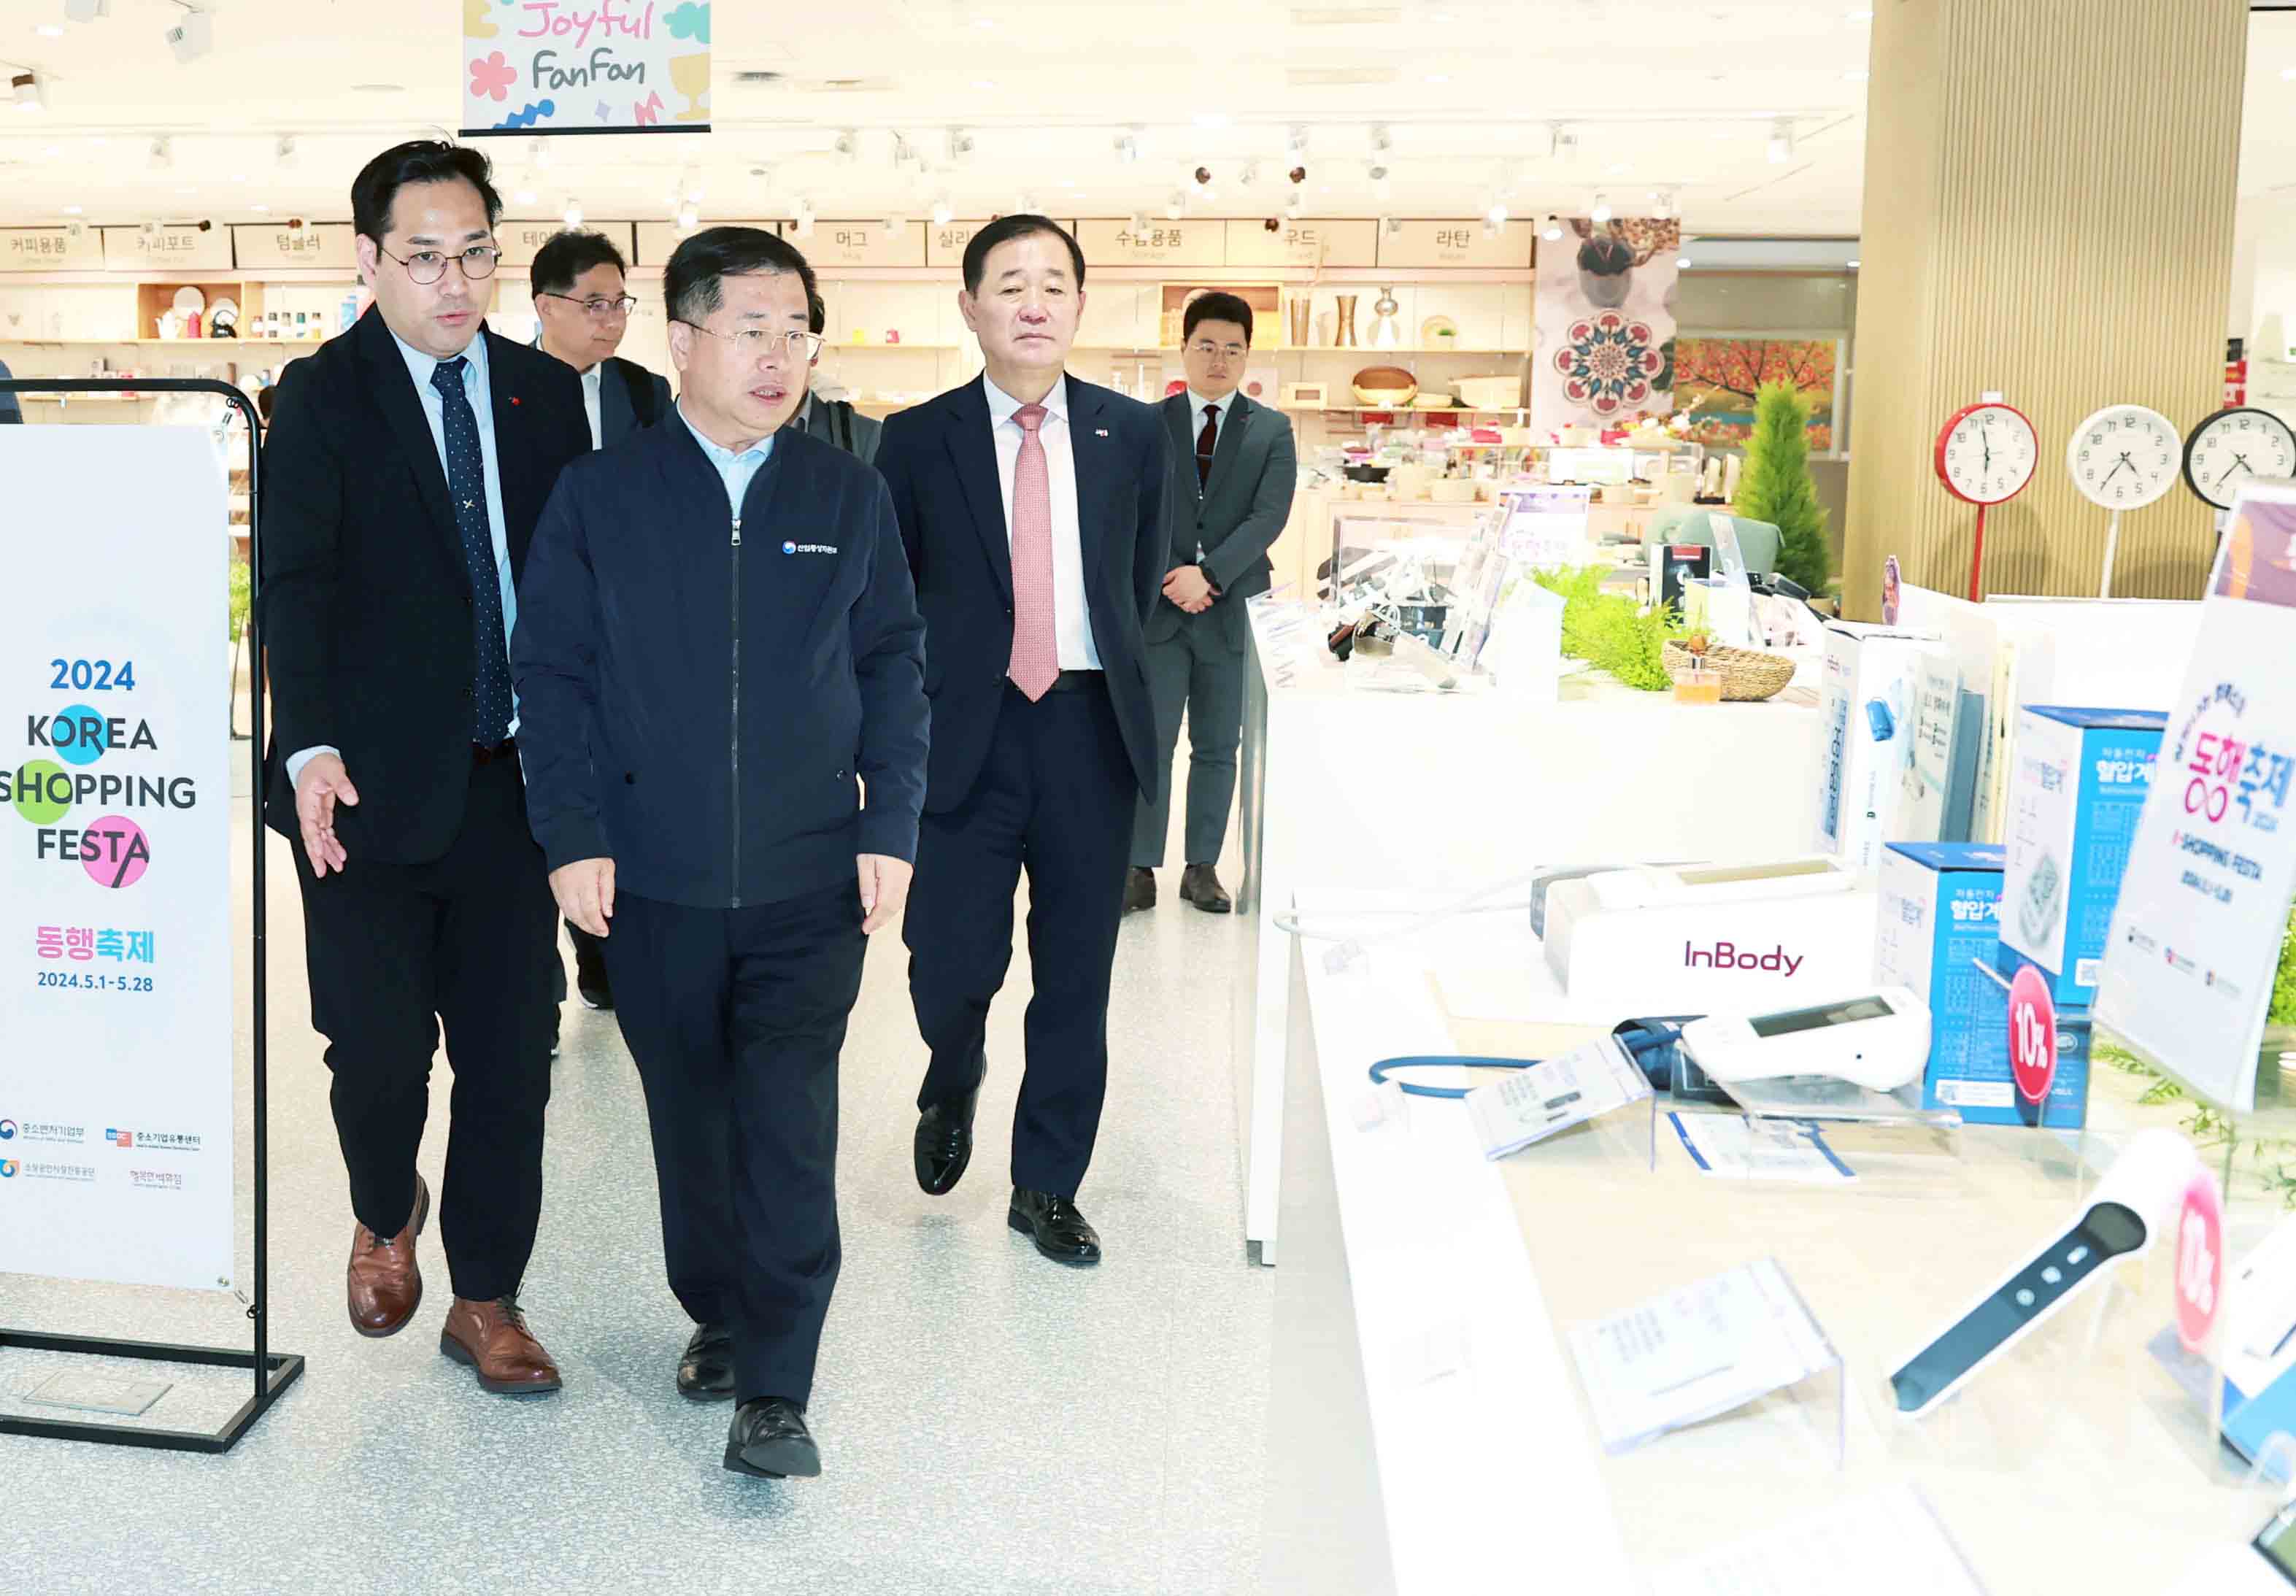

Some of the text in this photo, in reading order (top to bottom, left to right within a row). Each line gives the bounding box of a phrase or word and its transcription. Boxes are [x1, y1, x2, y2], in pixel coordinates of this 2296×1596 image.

[517, 0, 654, 48] Joyful
[11, 236, 67, 254] 커피용품
[836, 228, 868, 247] 머그
[939, 229, 972, 248] 실리
[1436, 229, 1471, 248] 라탄
[50, 658, 136, 690] 2024
[27, 714, 158, 756] KOREA
[0, 764, 196, 809] SHOPPING
[36, 828, 150, 889] FESTA
[35, 925, 155, 964] 동행축제
[1684, 940, 1804, 977] InBody
[36, 971, 154, 992] 2024.5.1-5.28
[2015, 1001, 2049, 1069] 10%
[136, 1132, 201, 1144] 중소기업유통센터
